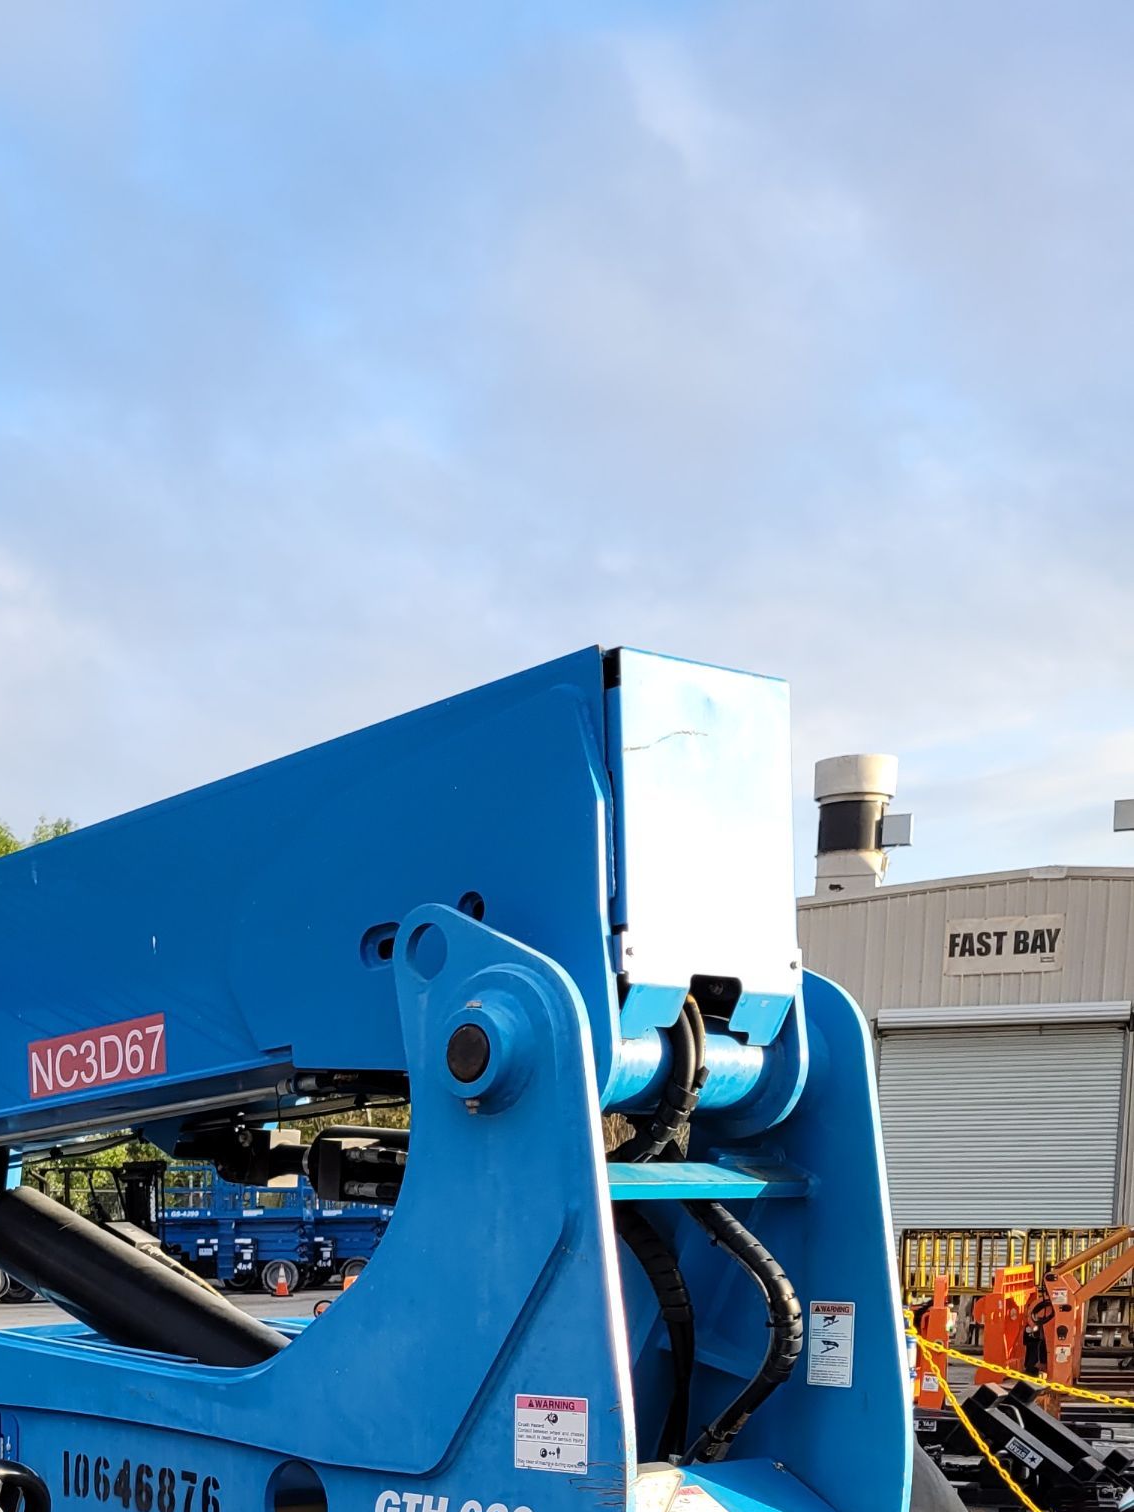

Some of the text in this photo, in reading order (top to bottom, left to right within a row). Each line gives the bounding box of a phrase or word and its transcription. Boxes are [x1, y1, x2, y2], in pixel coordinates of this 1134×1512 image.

[948, 928, 1061, 957] FAST BAY
[31, 1024, 164, 1094] NC3D67
[821, 1305, 850, 1314] WARNING
[535, 1399, 575, 1411] WARNING
